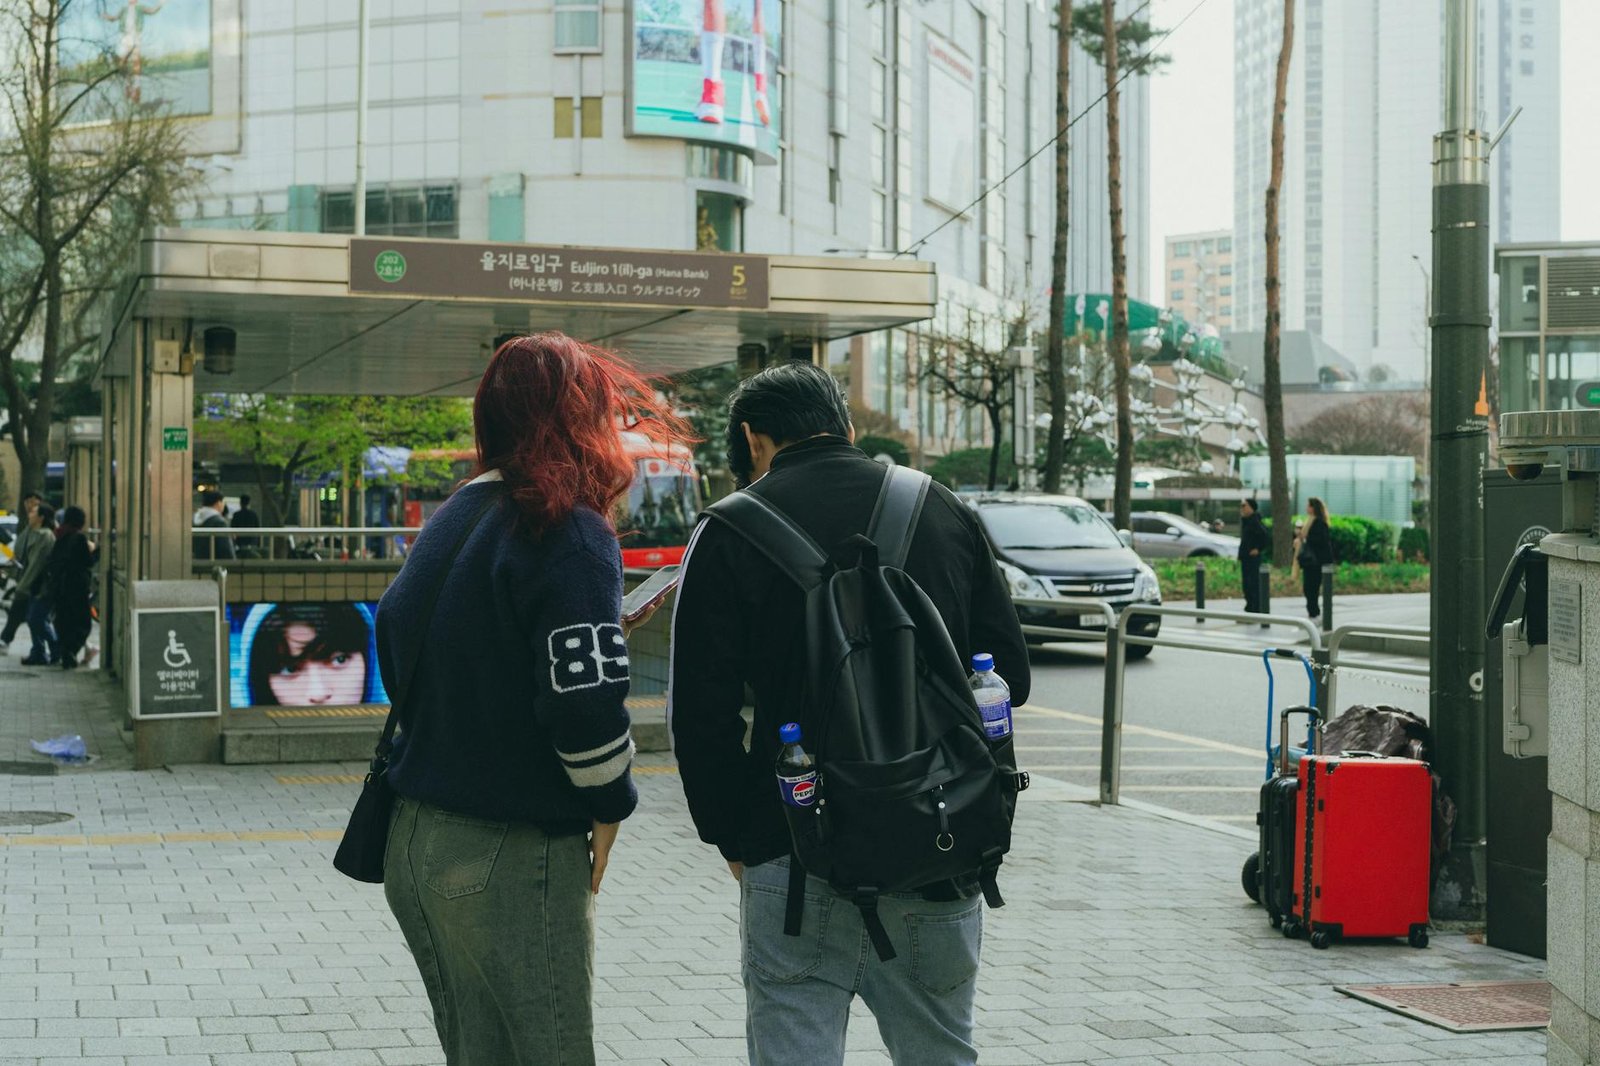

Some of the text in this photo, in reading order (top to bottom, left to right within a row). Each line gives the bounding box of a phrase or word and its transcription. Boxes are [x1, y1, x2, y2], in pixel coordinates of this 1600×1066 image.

[382, 255, 398, 264] 202
[480, 251, 709, 280] 을지로입구 Euljiro 1(il)-ga (Hana Bank)
[379, 265, 403, 276] 2호선
[731, 265, 746, 286] 5
[509, 277, 563, 293] (하나은행)
